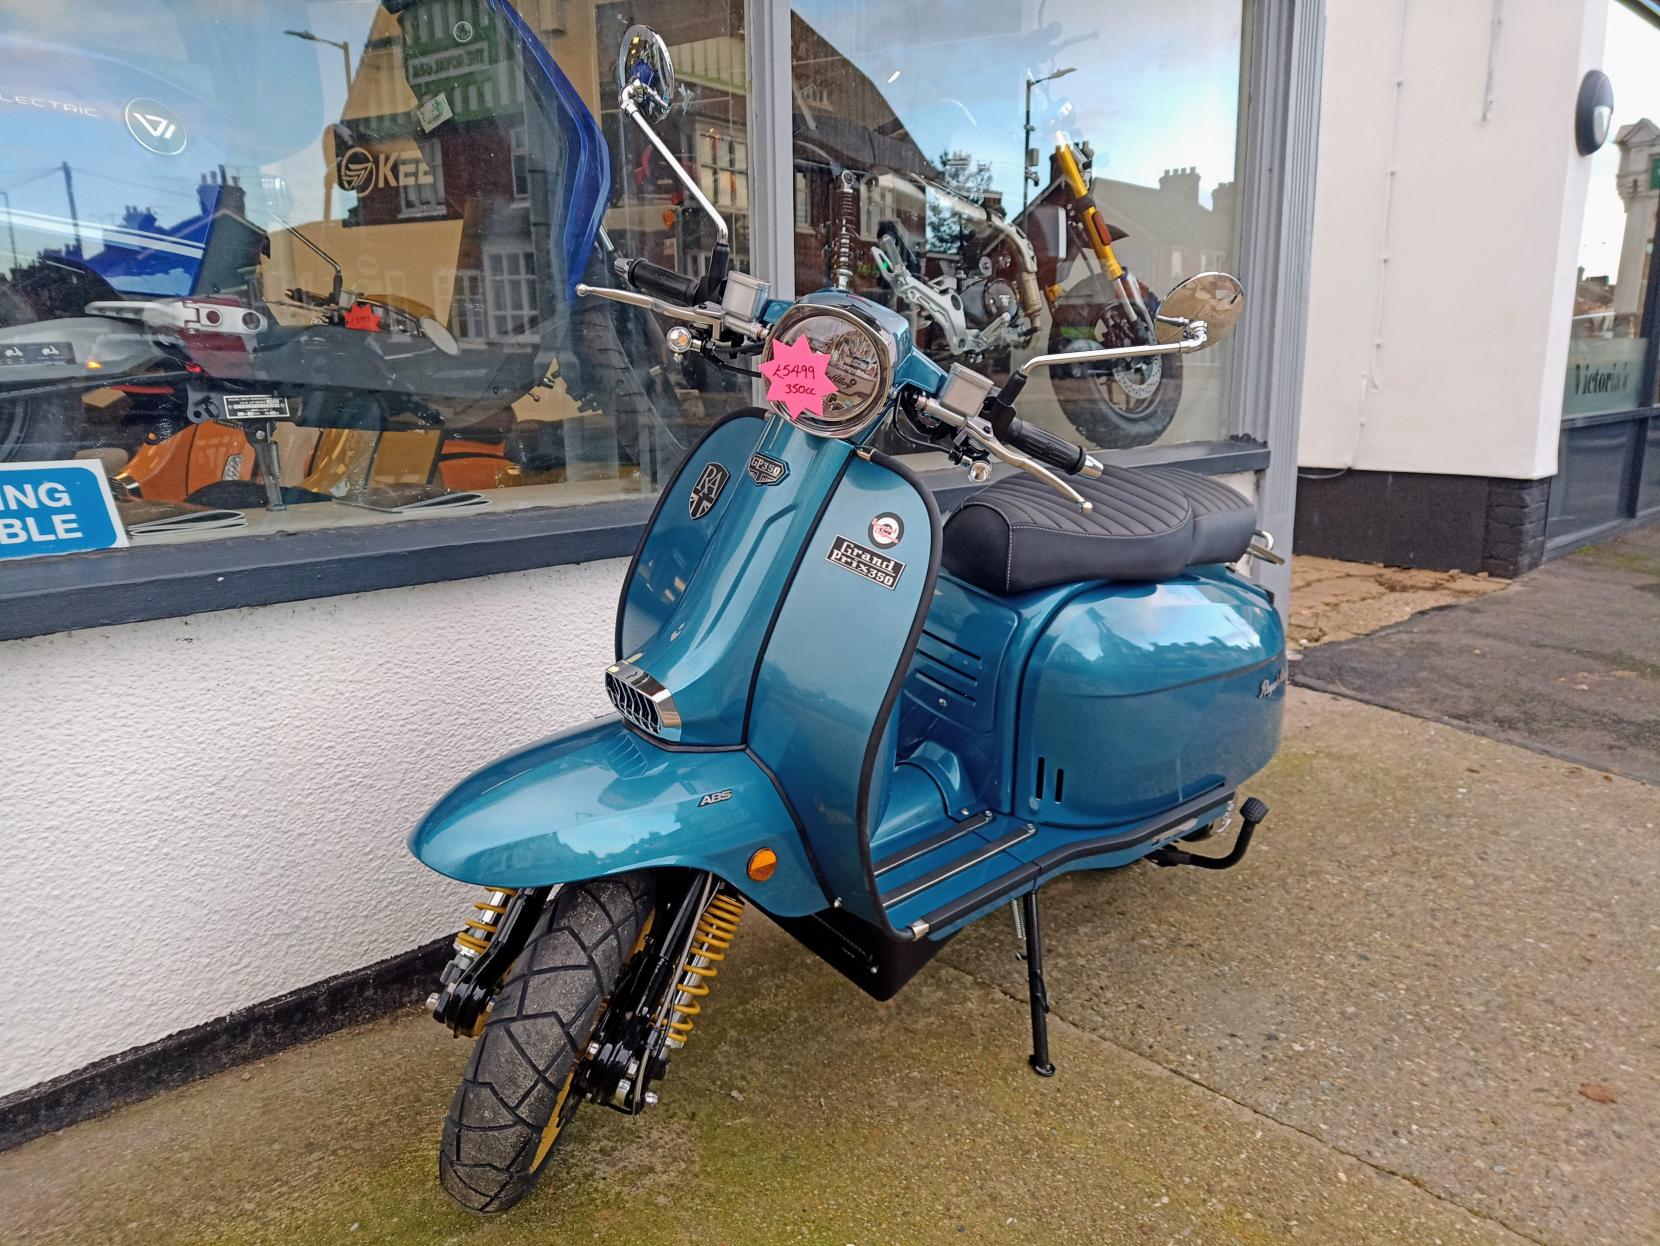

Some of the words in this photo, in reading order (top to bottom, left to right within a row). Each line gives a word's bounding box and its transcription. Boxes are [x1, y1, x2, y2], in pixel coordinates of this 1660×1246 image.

[773, 364, 815, 380] £5499
[785, 383, 816, 396] 350cc
[751, 457, 781, 477] GP350
[696, 465, 723, 498] RA
[840, 541, 895, 573] Grand
[700, 789, 732, 806] ABS
